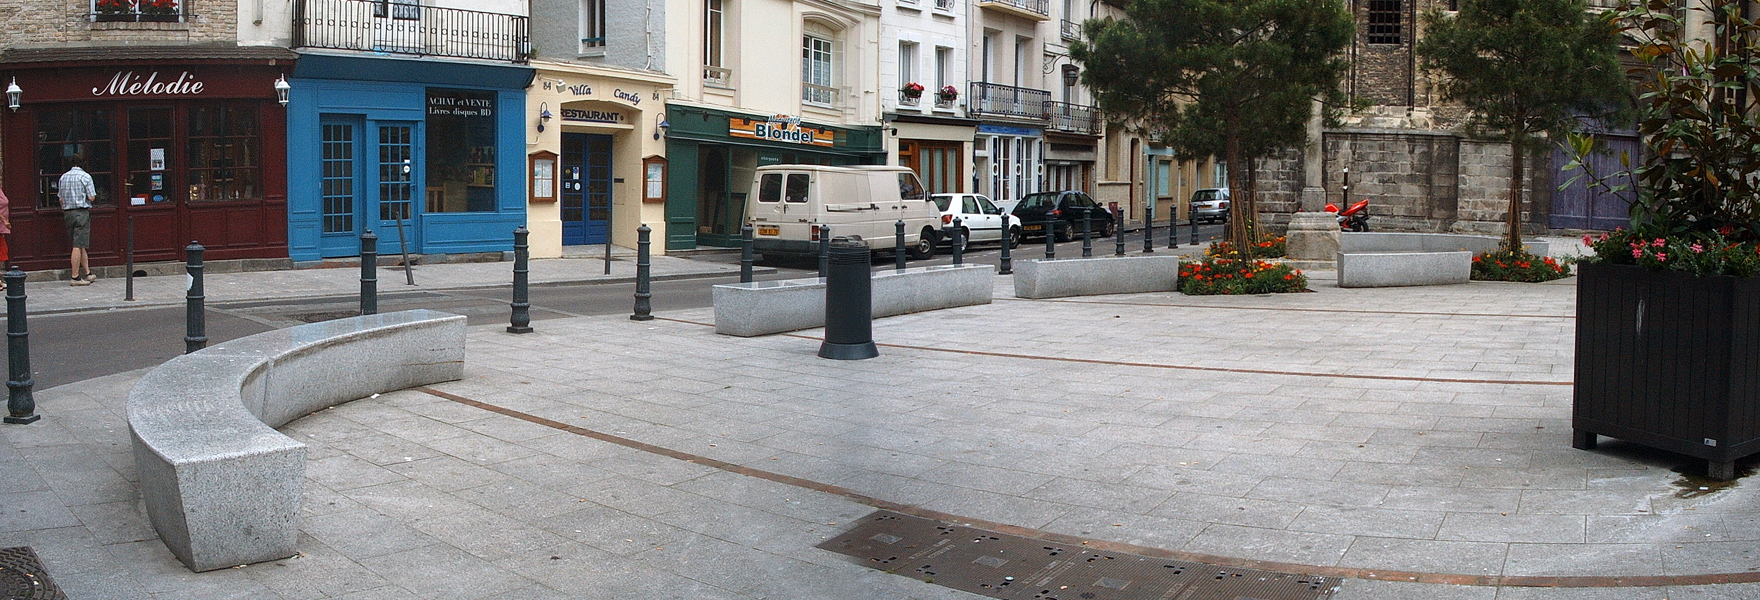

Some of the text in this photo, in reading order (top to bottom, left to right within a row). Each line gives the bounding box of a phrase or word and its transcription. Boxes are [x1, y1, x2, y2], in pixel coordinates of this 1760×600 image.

[92, 71, 204, 95] Mélodie
[543, 81, 552, 91] 84
[568, 84, 641, 106] Villa Candy
[652, 92, 660, 101] 84
[429, 97, 455, 105] ACHAT
[465, 99, 491, 107] VENTE
[453, 108, 478, 117] disques
[560, 108, 620, 121] RESTAURANT
[755, 124, 813, 142] Blondel
